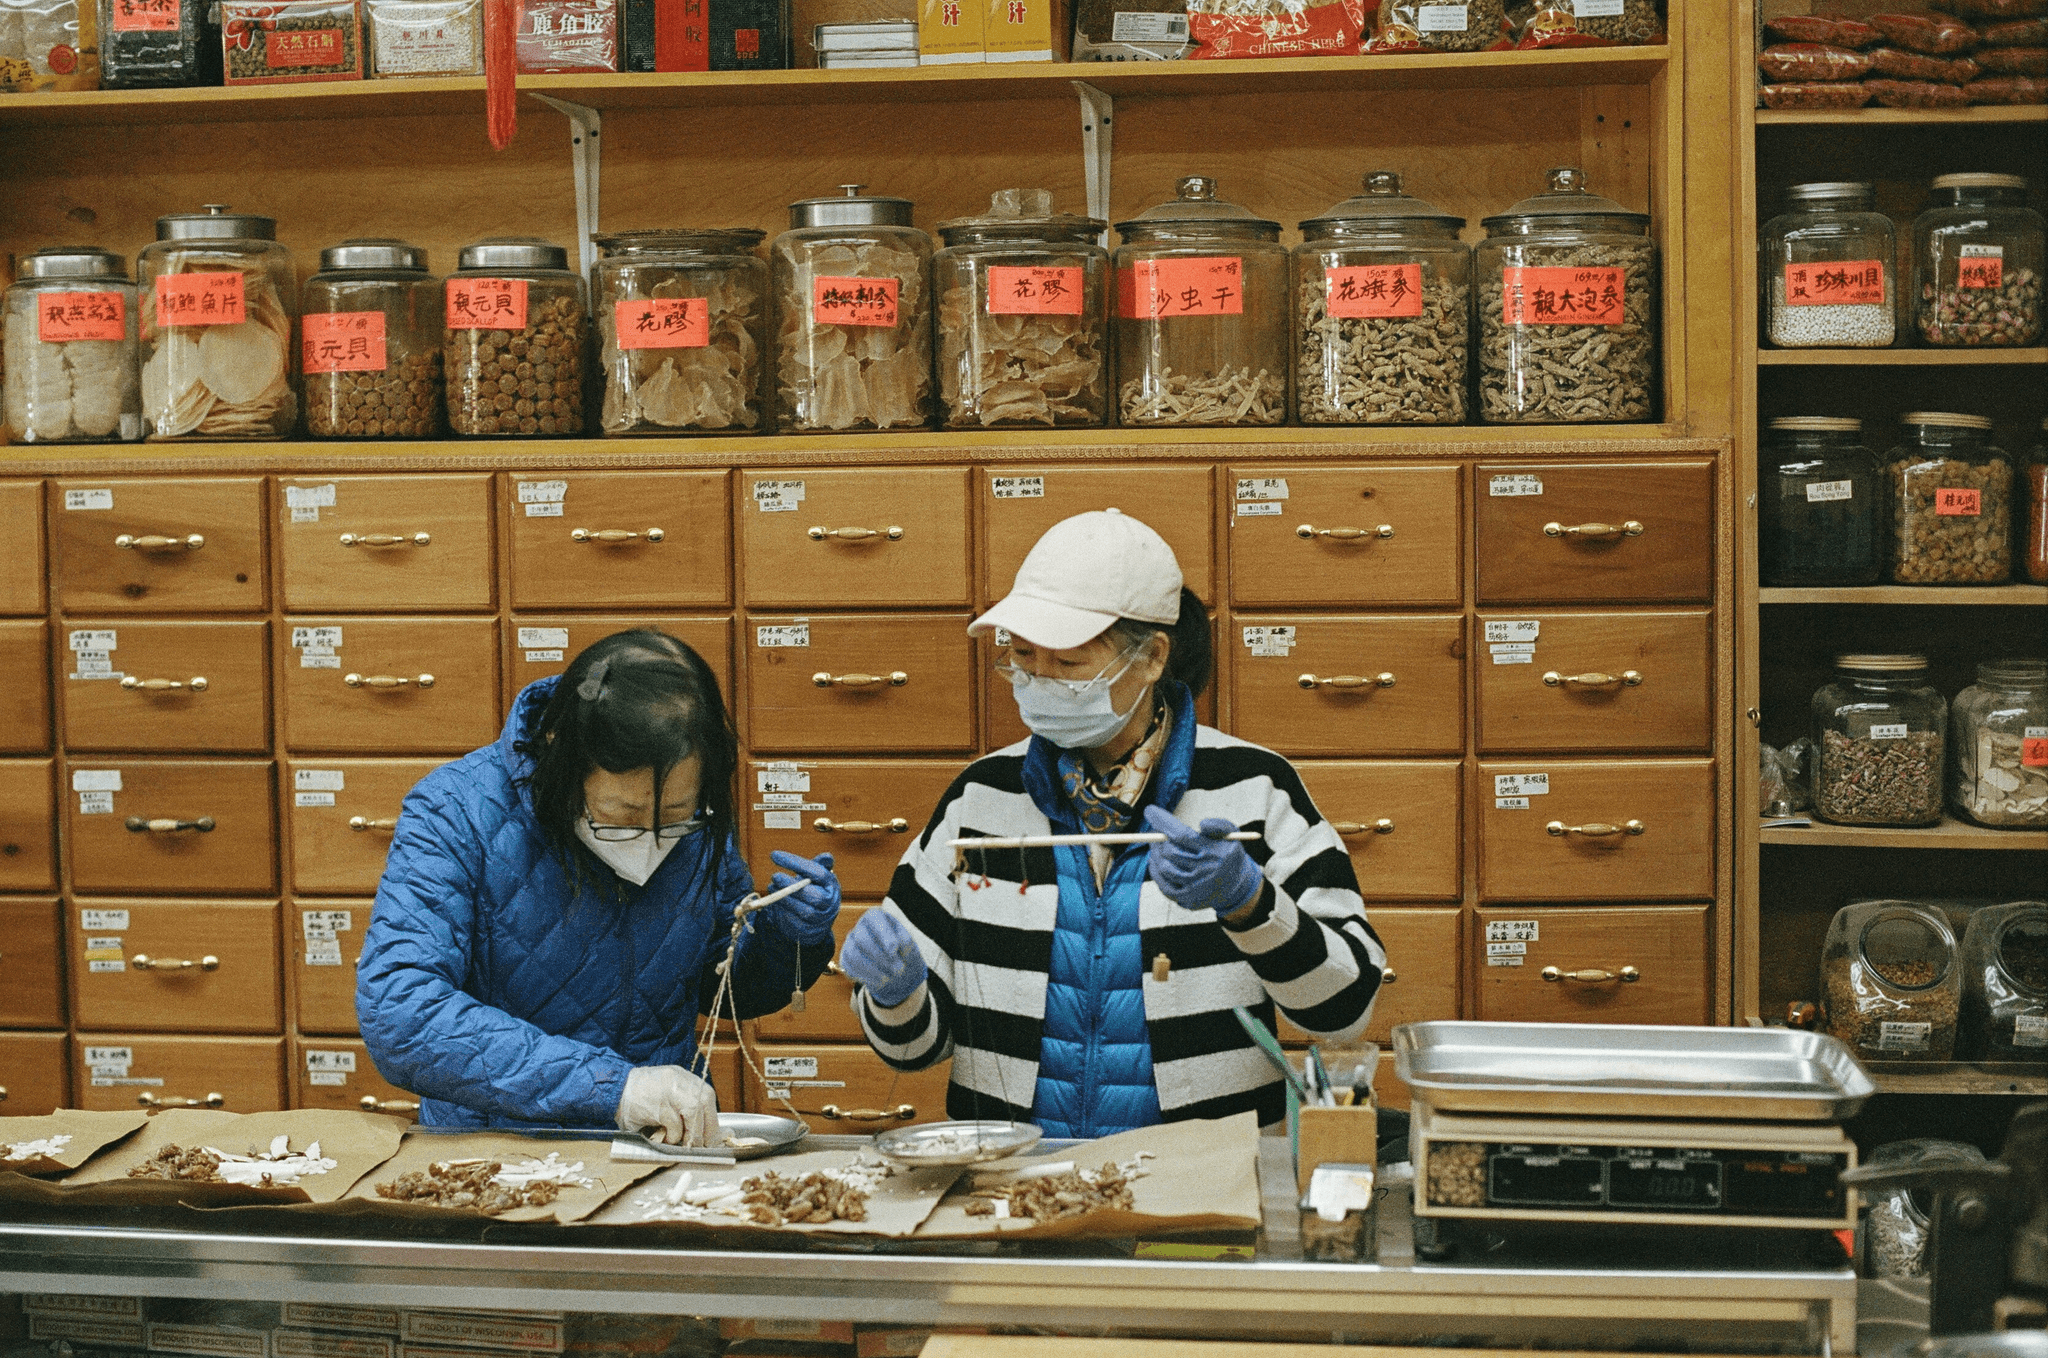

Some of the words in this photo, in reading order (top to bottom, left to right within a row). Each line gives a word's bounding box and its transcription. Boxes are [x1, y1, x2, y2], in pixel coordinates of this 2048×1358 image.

[1248, 41, 1305, 55] CHINESE
[1311, 38, 1345, 50] HERB
[1012, 278, 1070, 304] 花膠
[636, 311, 694, 336] 花膠
[418, 1322, 460, 1333] PRODUCT
